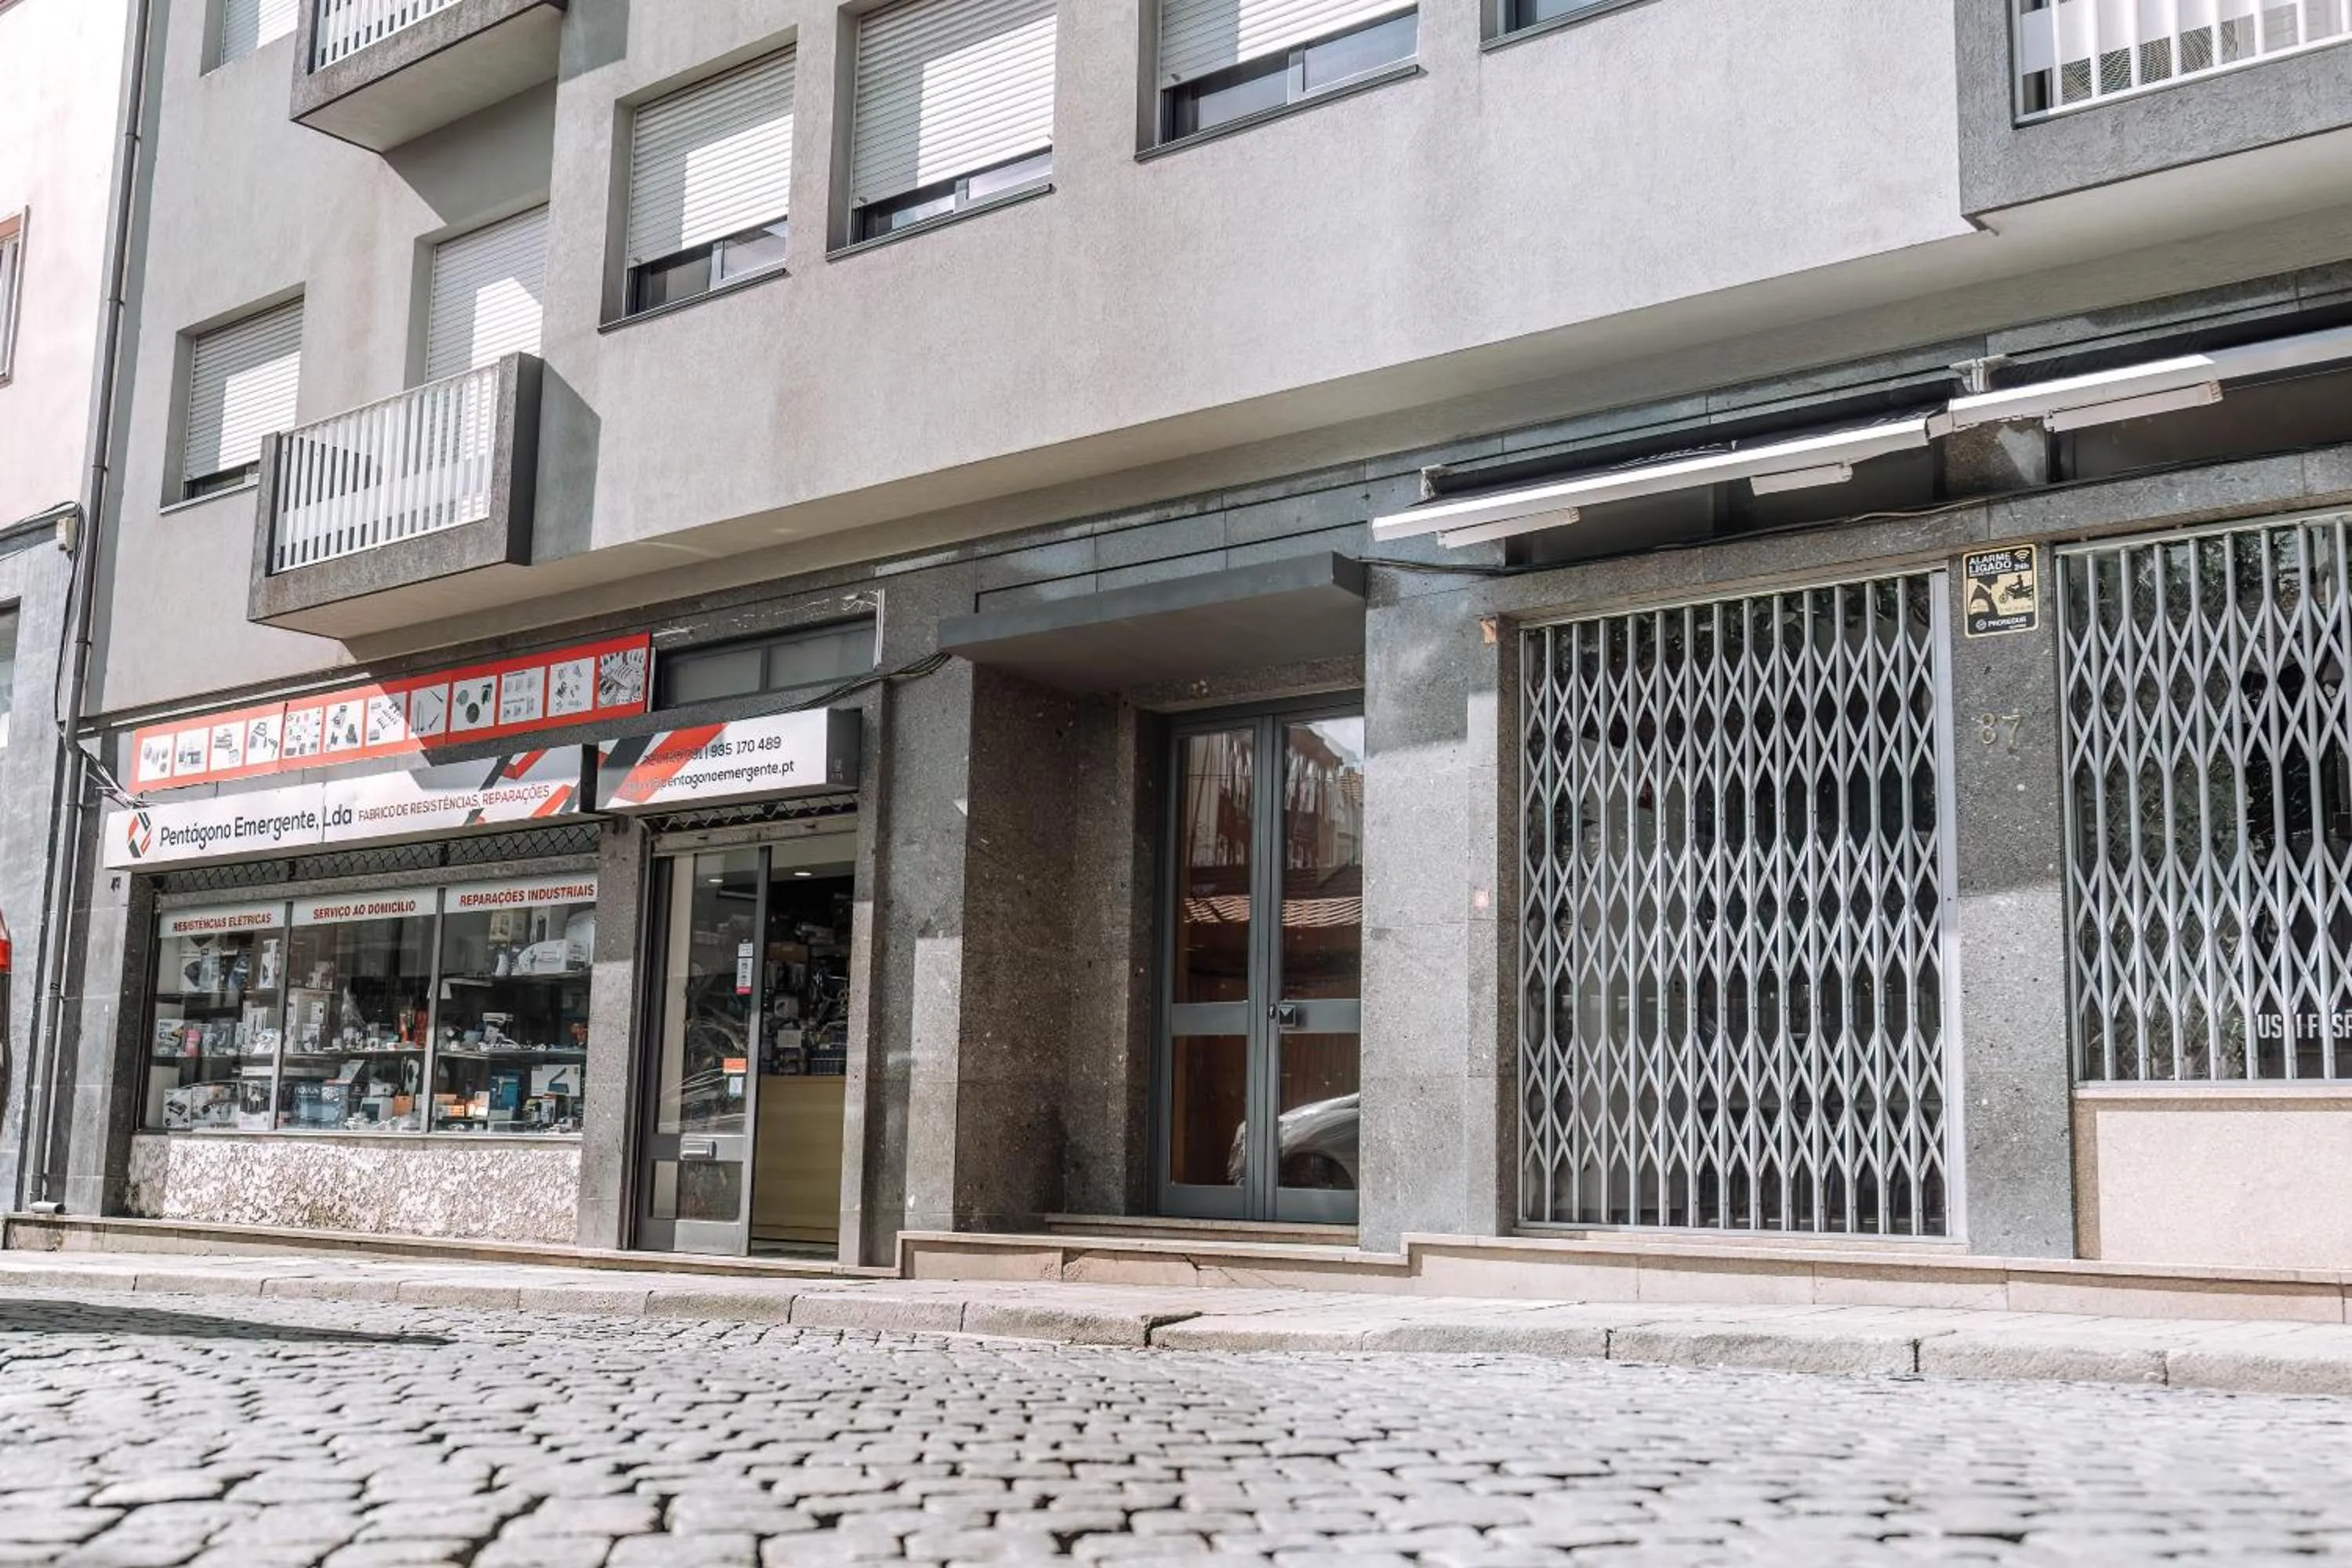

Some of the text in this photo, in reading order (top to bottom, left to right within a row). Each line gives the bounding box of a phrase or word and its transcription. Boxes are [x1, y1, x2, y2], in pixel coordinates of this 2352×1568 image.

[1969, 552, 2011, 566] ALARME
[1969, 561, 2013, 575] LIGADO
[710, 742, 732, 758] 935
[736, 739, 755, 754] 170
[757, 735, 782, 750] 489
[358, 803, 395, 822] FABRICO
[396, 801, 408, 816] DE
[482, 785, 550, 806] REPARAÇÕES
[159, 804, 353, 850] Pentágono Emergente, Lda
[459, 883, 595, 907] REPARAÇÕES INDUSTRIAIS
[313, 905, 350, 920] SERVIÇO
[352, 904, 367, 916] AO
